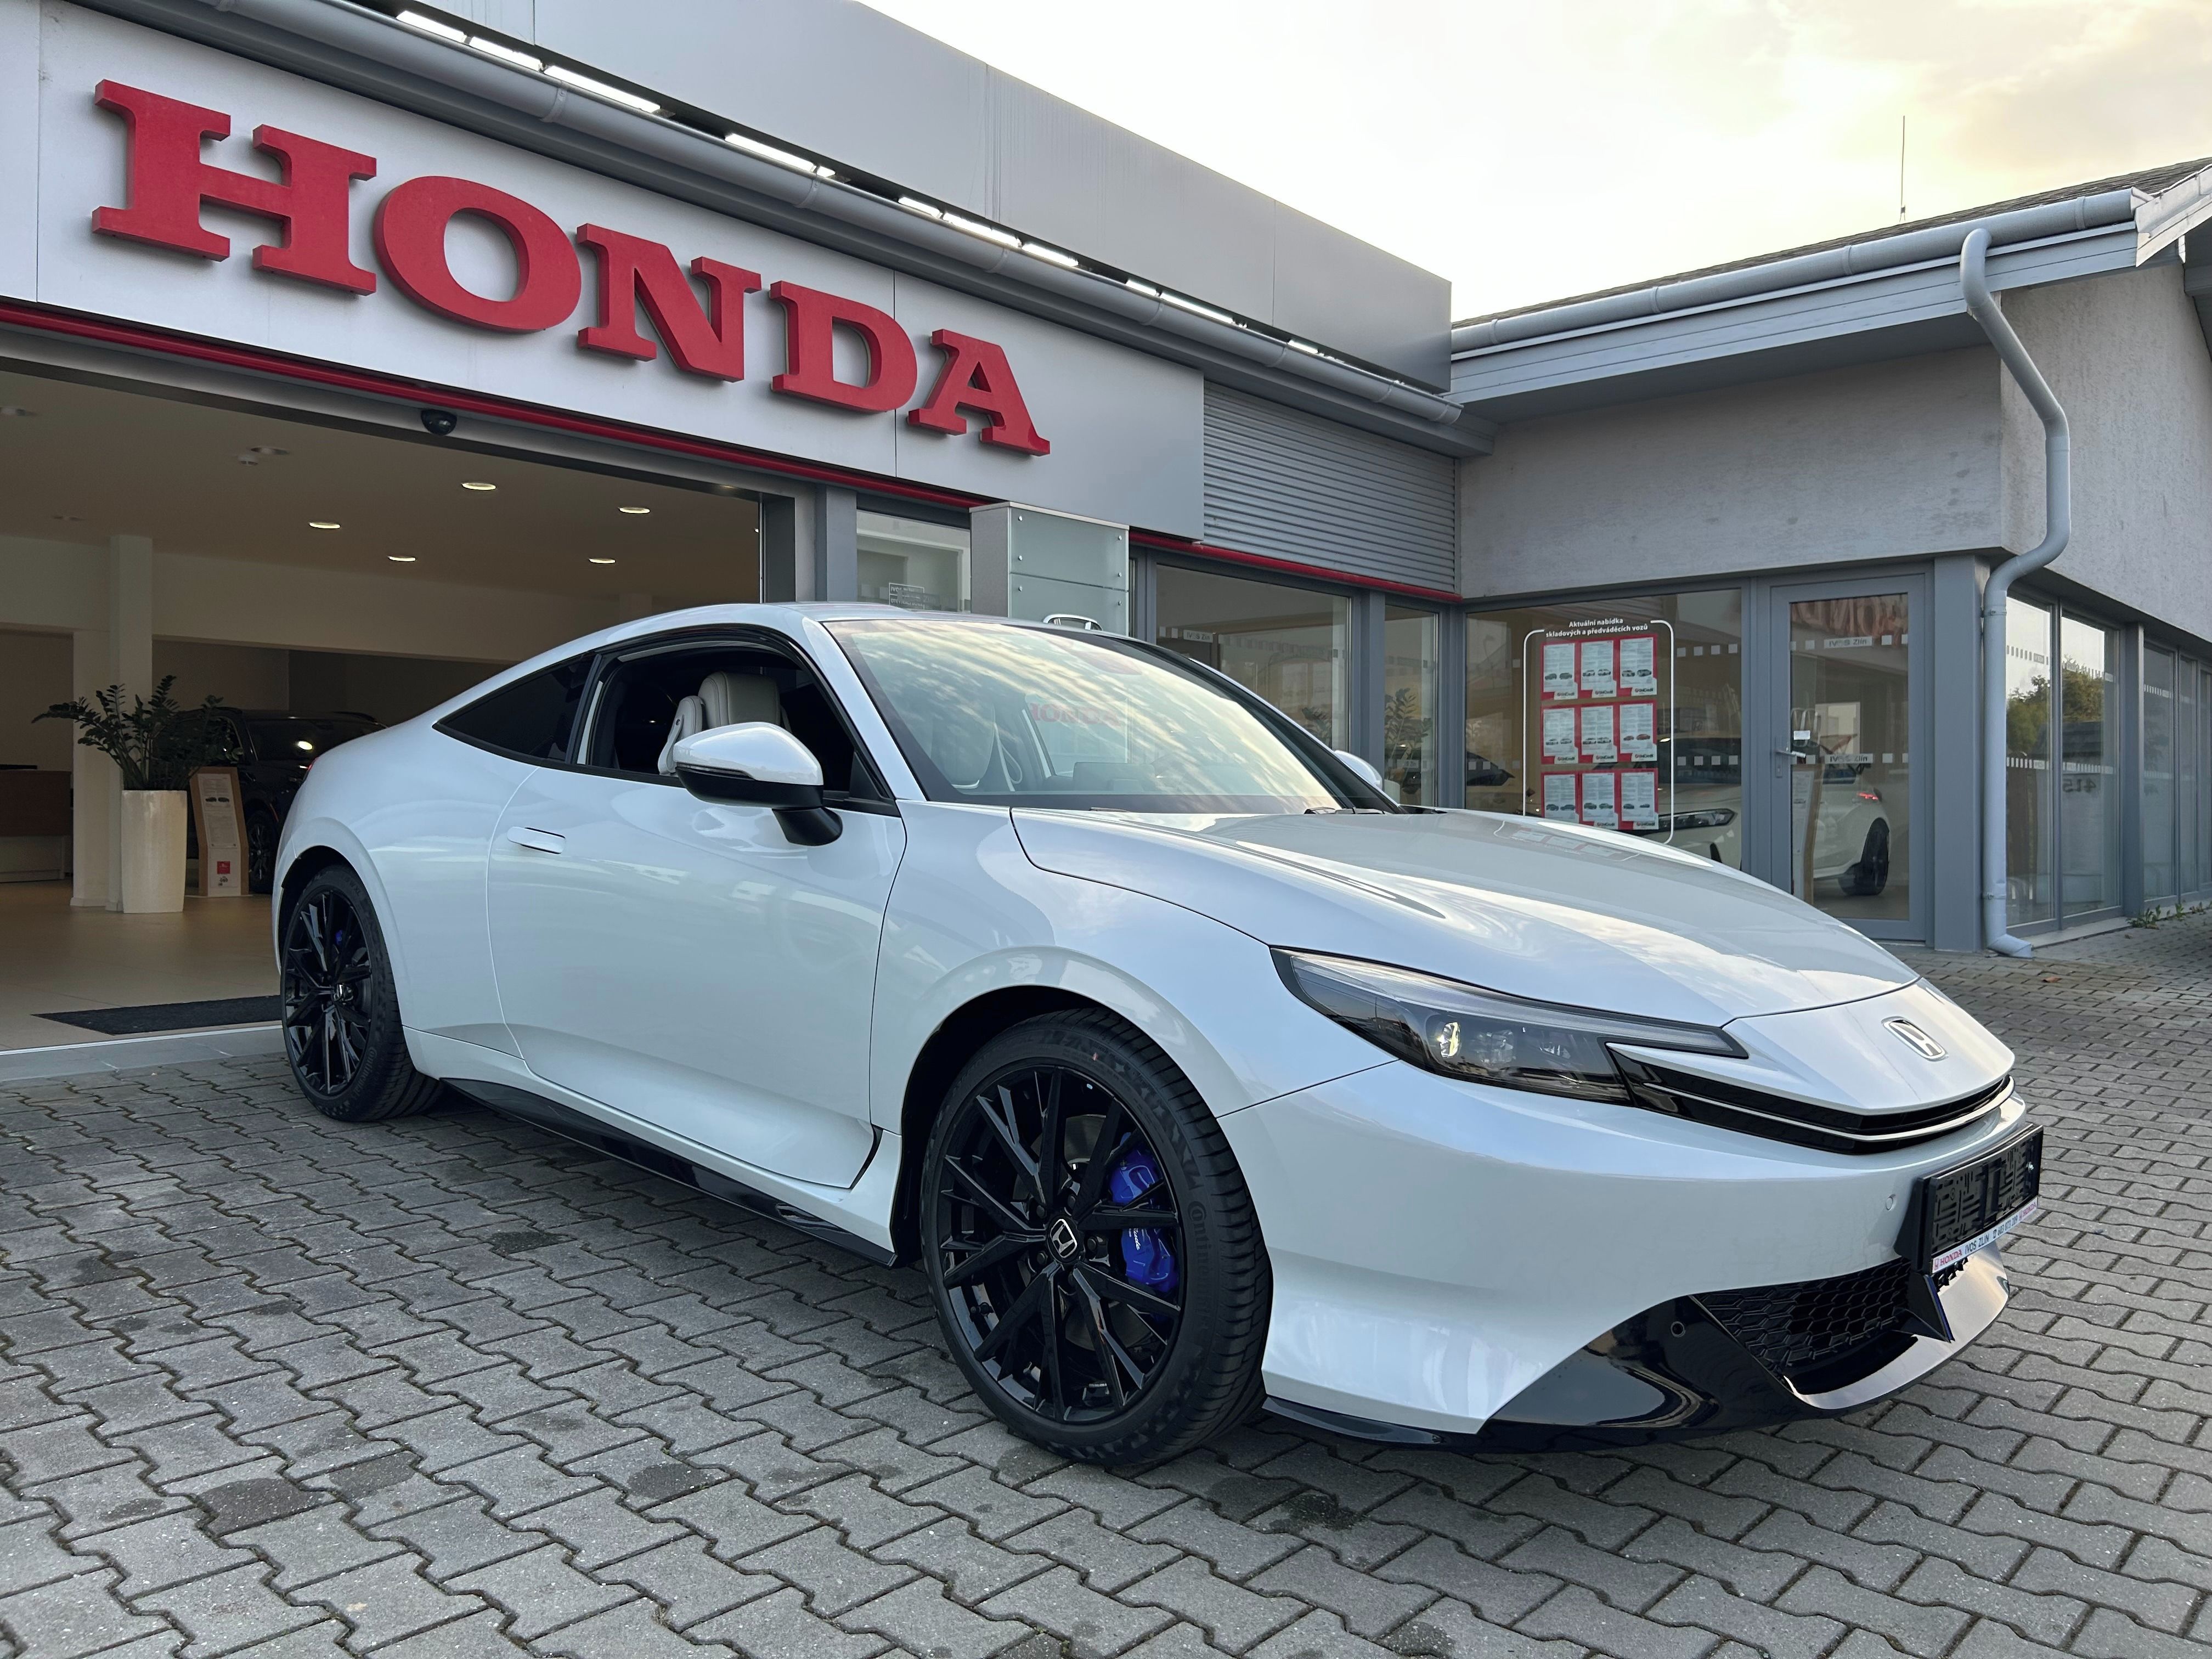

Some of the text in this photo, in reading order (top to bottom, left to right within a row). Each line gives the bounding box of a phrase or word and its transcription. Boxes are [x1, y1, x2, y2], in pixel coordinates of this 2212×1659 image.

[93, 79, 1051, 457] HONDA
[1545, 629, 1581, 637] skladových
[1587, 625, 1631, 636] předváděcích
[1568, 617, 1623, 628] Aktuální nabídka
[1940, 1249, 1963, 1266] HONDA
[1965, 1240, 1977, 1254] IVOS
